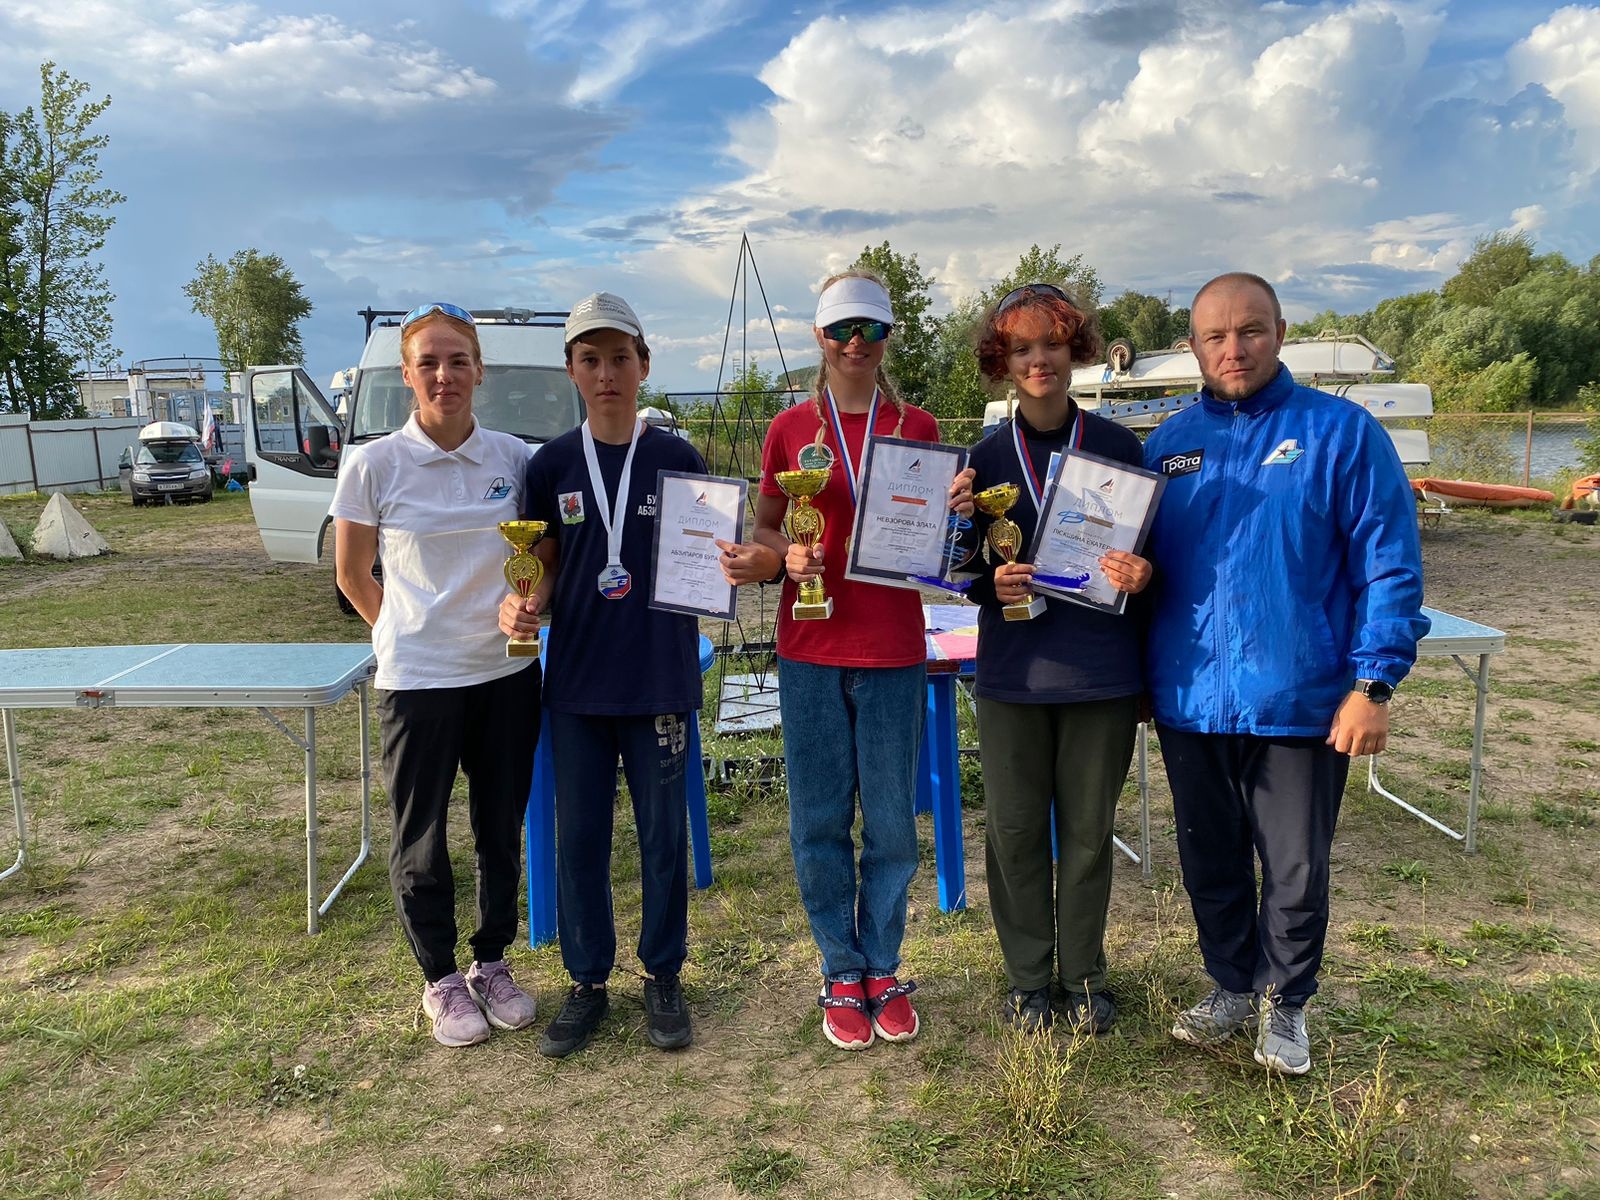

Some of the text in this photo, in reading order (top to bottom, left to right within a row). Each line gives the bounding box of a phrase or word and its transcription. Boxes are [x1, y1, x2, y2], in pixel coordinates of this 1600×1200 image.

[888, 482, 934, 495] ДИПЛОМ
[646, 494, 658, 505] БУ
[637, 505, 658, 516] АБЗИ
[1073, 498, 1123, 519] ДИПЛОМ
[678, 515, 719, 528] ДИПЛОМ
[877, 516, 915, 527] НЕВЗОРОВА
[1086, 539, 1117, 551] ЕКАТЕРИ
